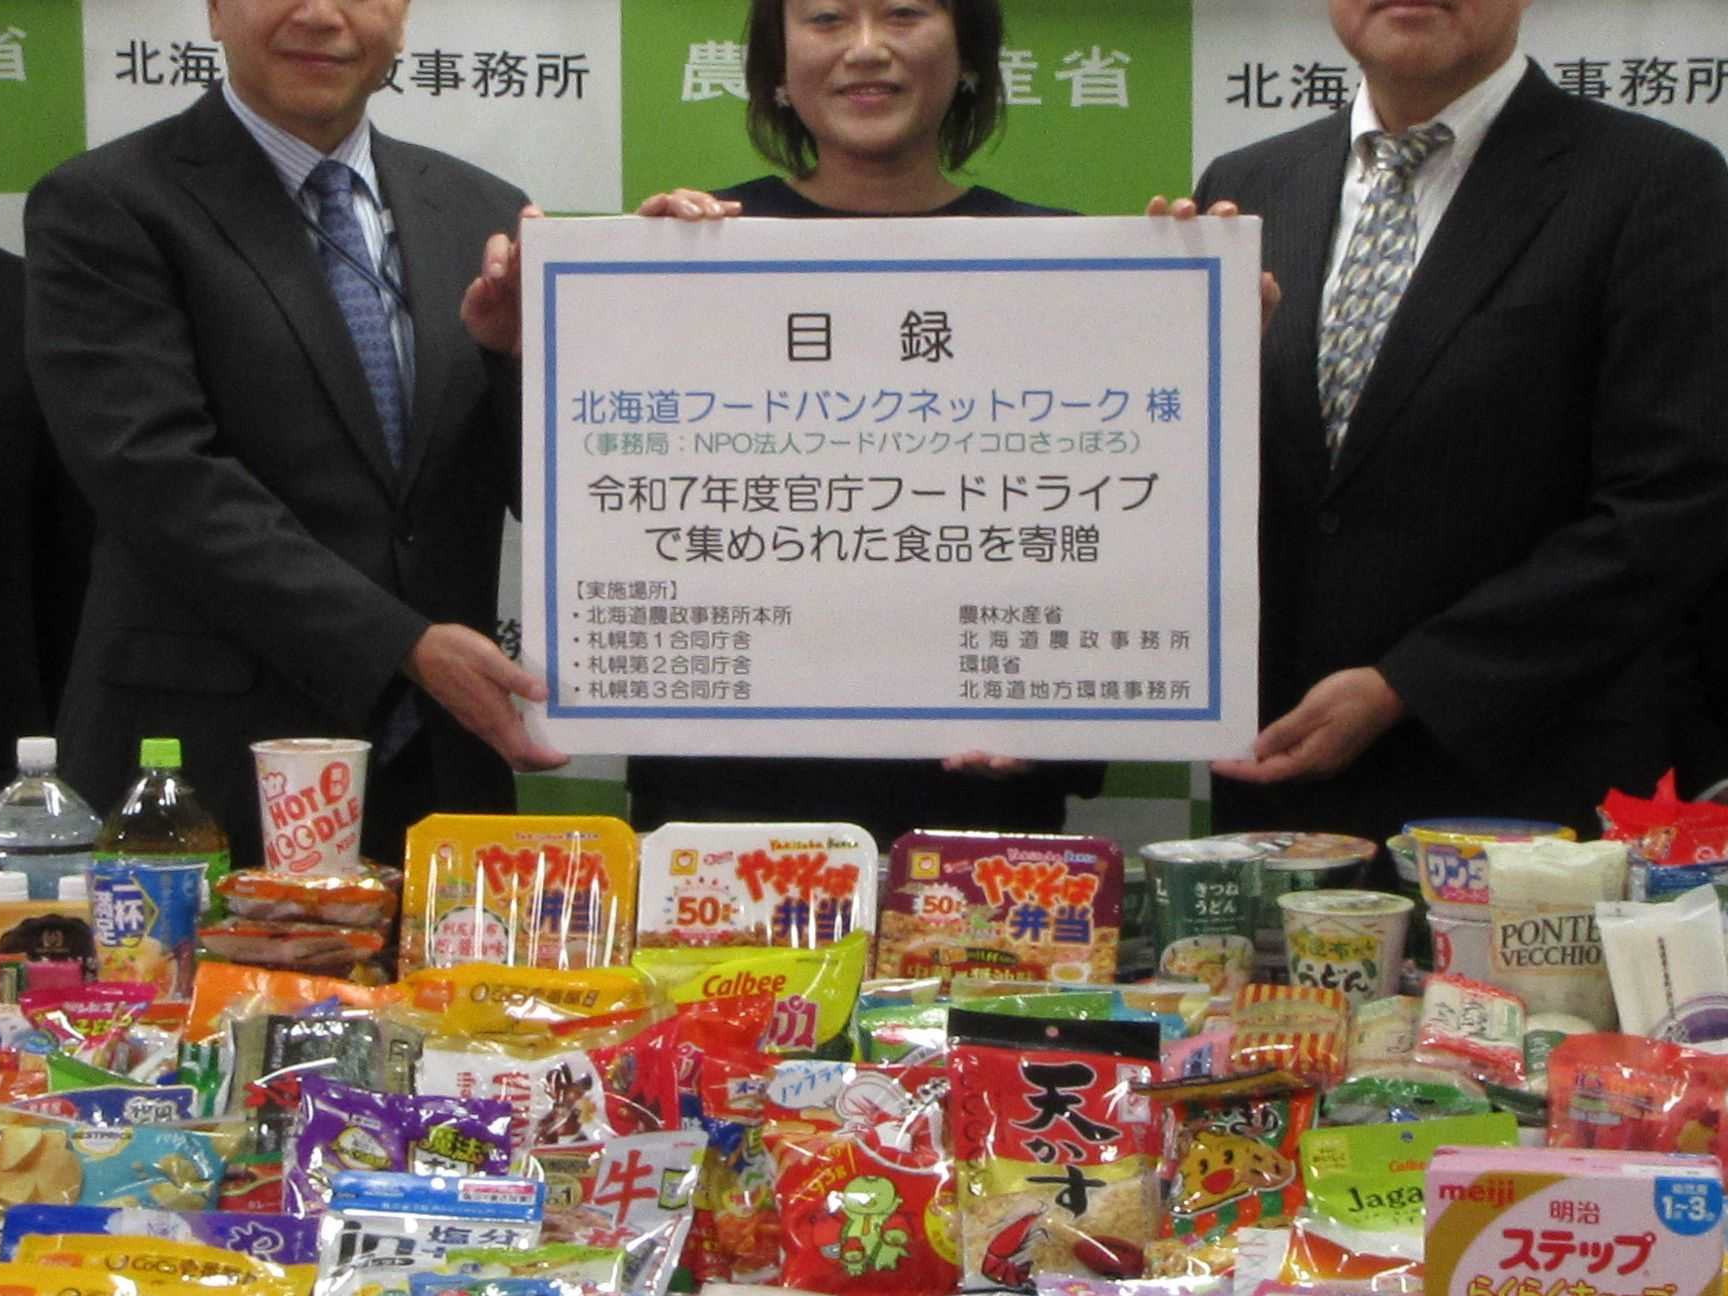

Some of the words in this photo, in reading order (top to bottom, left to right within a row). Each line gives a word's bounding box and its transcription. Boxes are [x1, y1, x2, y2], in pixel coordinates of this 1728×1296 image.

[571, 387, 1131, 427] 北海道フードバンクネットワーク
[1145, 386, 1183, 424] 様
[586, 473, 1159, 515] 令和7年度官庁フードドライブ
[644, 523, 1101, 565] で集められた食品を寄贈
[574, 580, 679, 601] 【実施場所】
[958, 605, 1063, 625] 農林水産省
[958, 629, 1192, 650] 北海道農政事務所
[958, 654, 1022, 675] 環境省
[958, 678, 1192, 700] 北海道地方環境事務所
[269, 785, 320, 830] HOT
[265, 796, 361, 869] NOODLE
[735, 848, 860, 902] やきそば
[974, 854, 1100, 909] やきそば
[1193, 880, 1240, 899] きつね
[1193, 901, 1238, 916] うどん
[1005, 904, 1095, 947] 弁当
[1499, 945, 1602, 969] VECCHIO
[700, 970, 788, 1000] Calbee
[1007, 1060, 1123, 1219] 天かす
[1345, 1184, 1425, 1215] Jaga
[1438, 1179, 1517, 1211] meiji
[1548, 1200, 1601, 1226] 明治
[1498, 1227, 1658, 1276] ステップ
